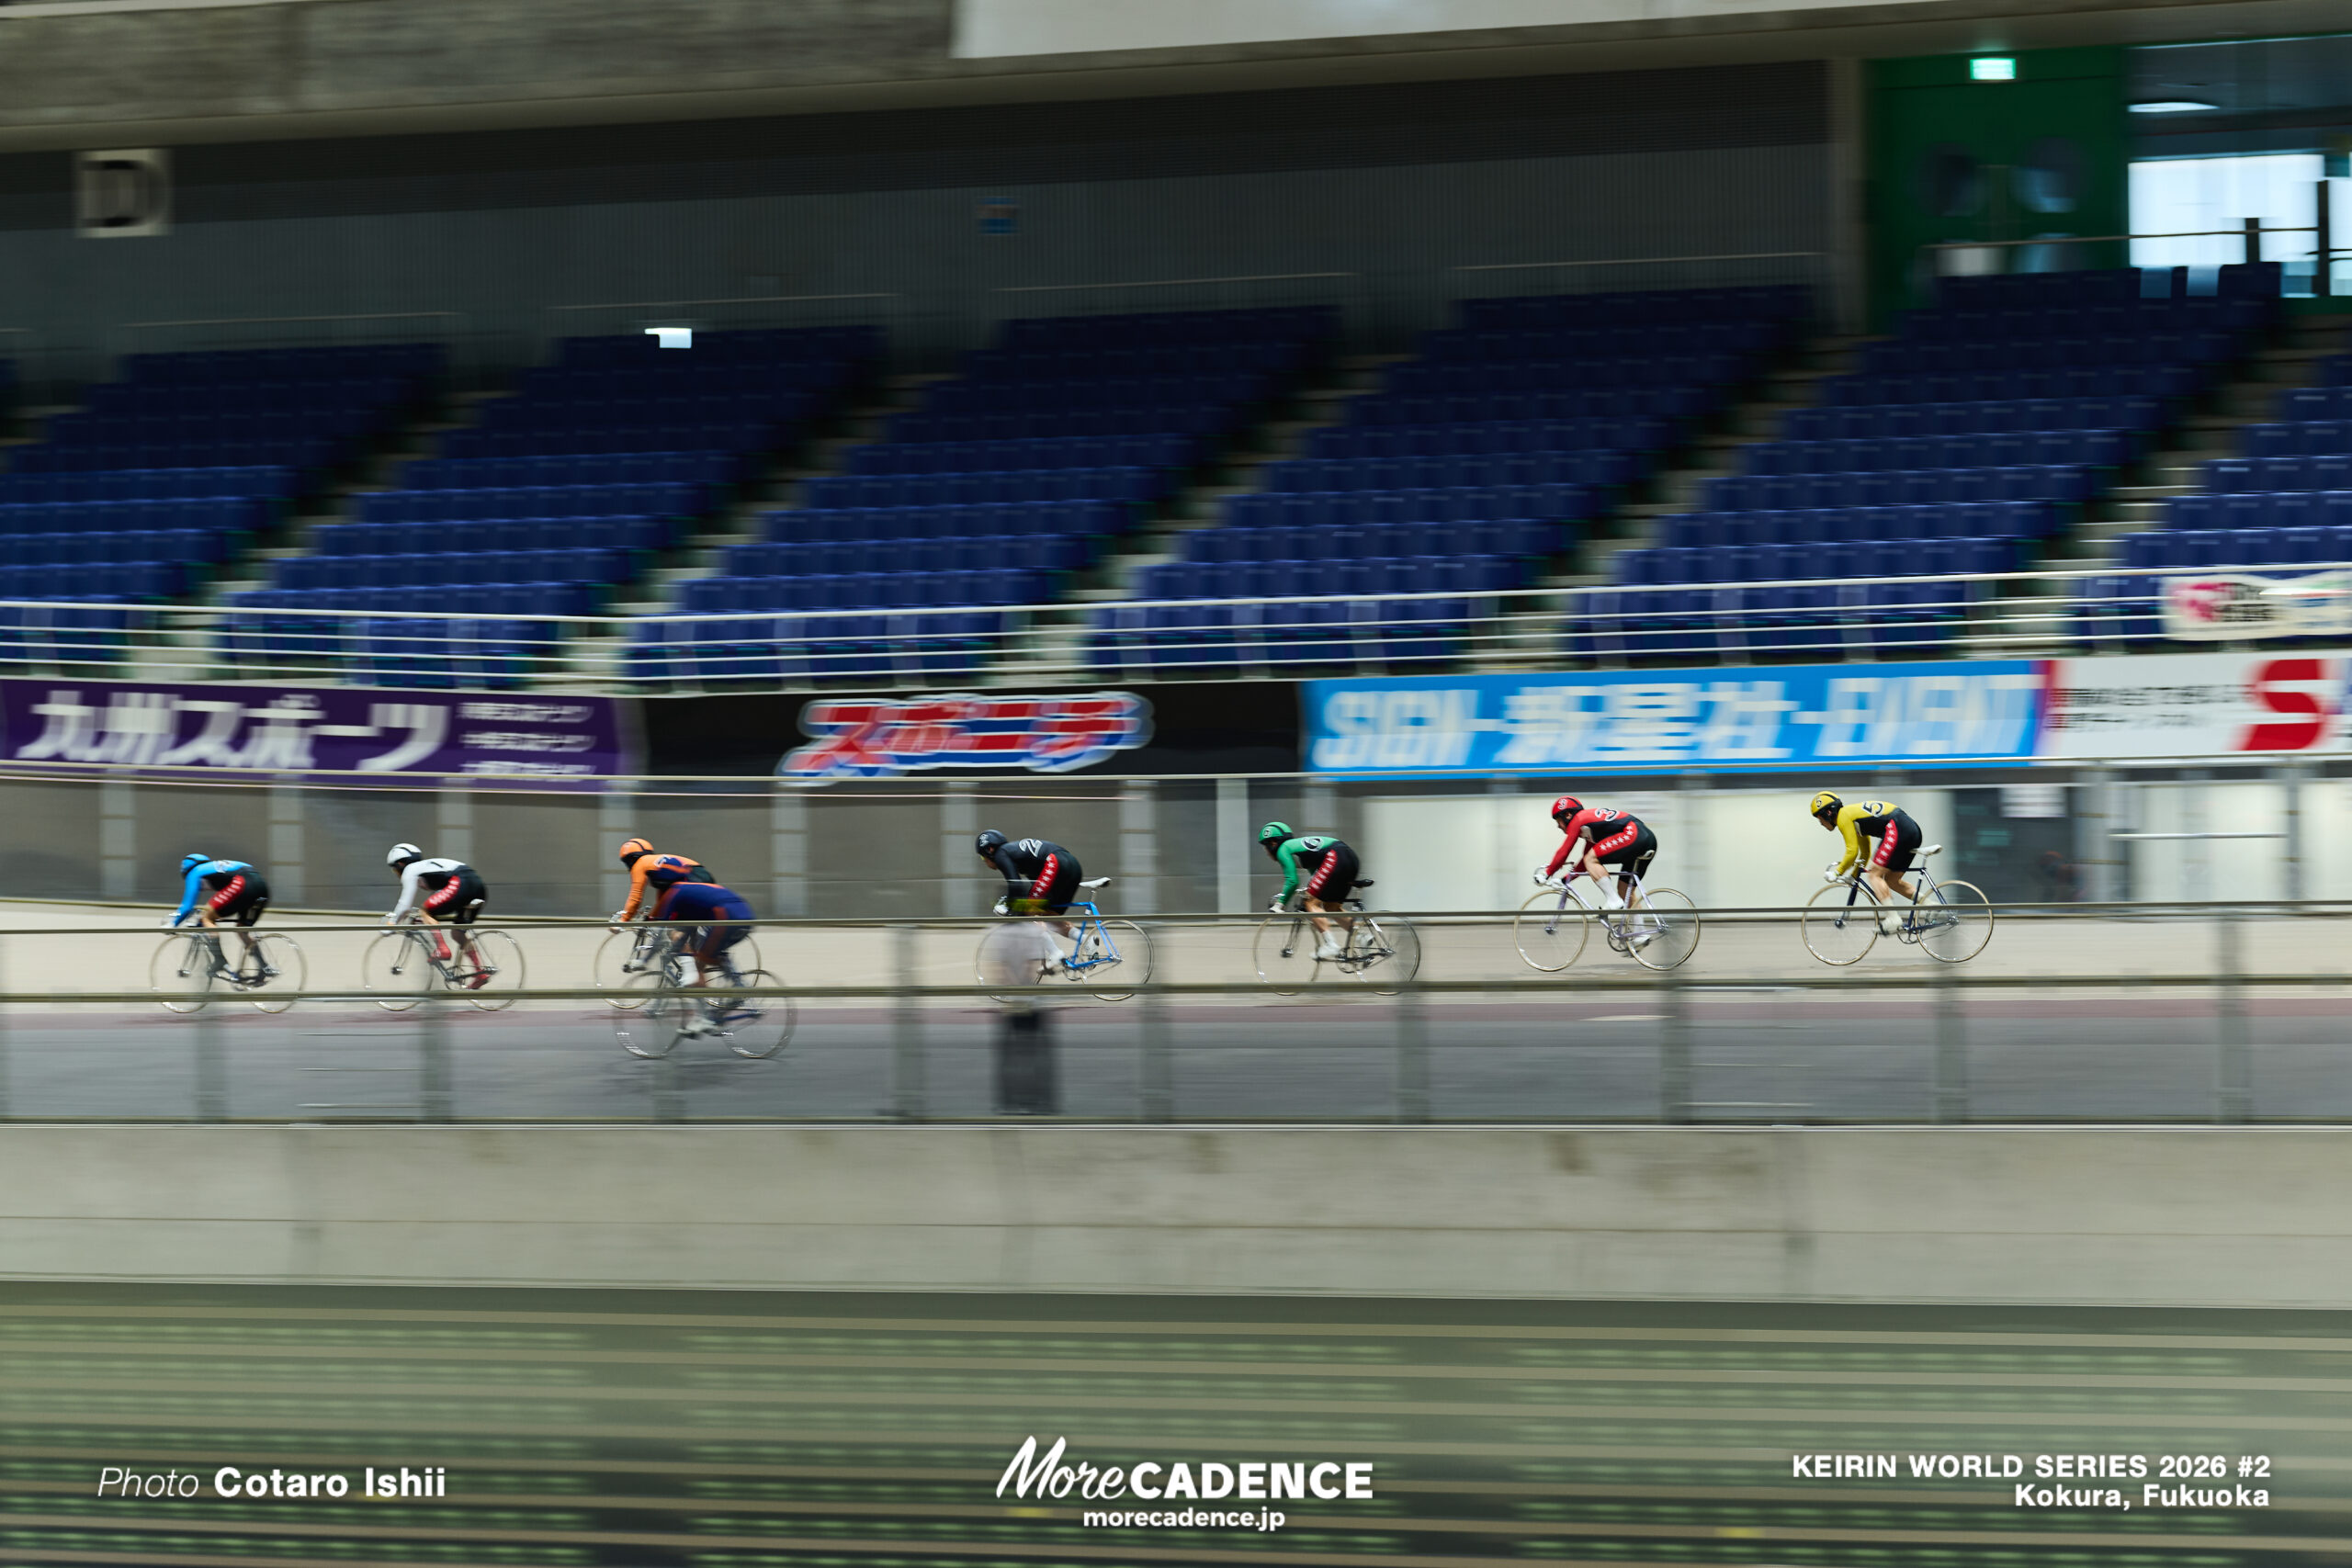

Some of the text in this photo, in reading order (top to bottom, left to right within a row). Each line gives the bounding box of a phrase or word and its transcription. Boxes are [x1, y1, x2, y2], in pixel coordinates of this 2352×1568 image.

[1594, 808, 1620, 822] 3
[1862, 800, 1884, 818] 5
[1019, 838, 1043, 858] 2
